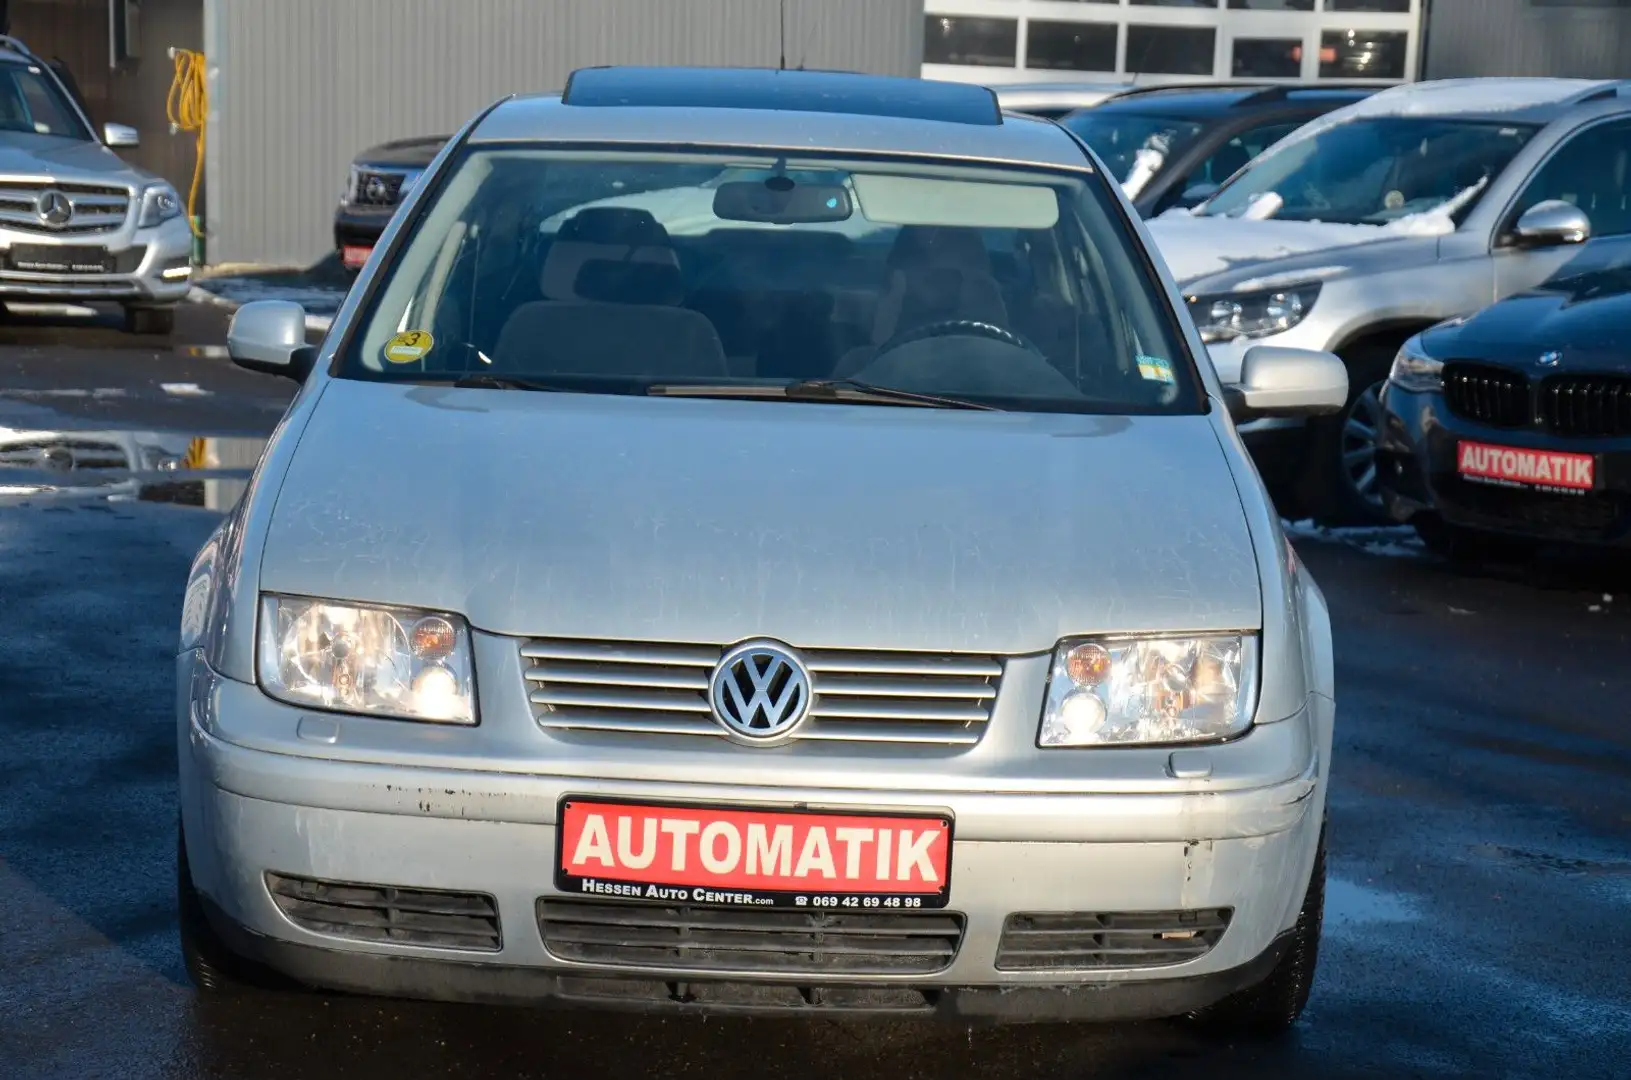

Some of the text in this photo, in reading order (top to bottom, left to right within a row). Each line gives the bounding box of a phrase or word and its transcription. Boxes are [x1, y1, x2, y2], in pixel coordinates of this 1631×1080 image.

[1462, 446, 1593, 485] AUTOMATIK
[715, 647, 808, 736] VW
[572, 813, 941, 881] AUTOMATIK
[812, 896, 838, 907] 069
[841, 896, 859, 907] 42
[863, 897, 880, 907] 69
[883, 897, 901, 907] 48
[904, 897, 922, 908] 98
